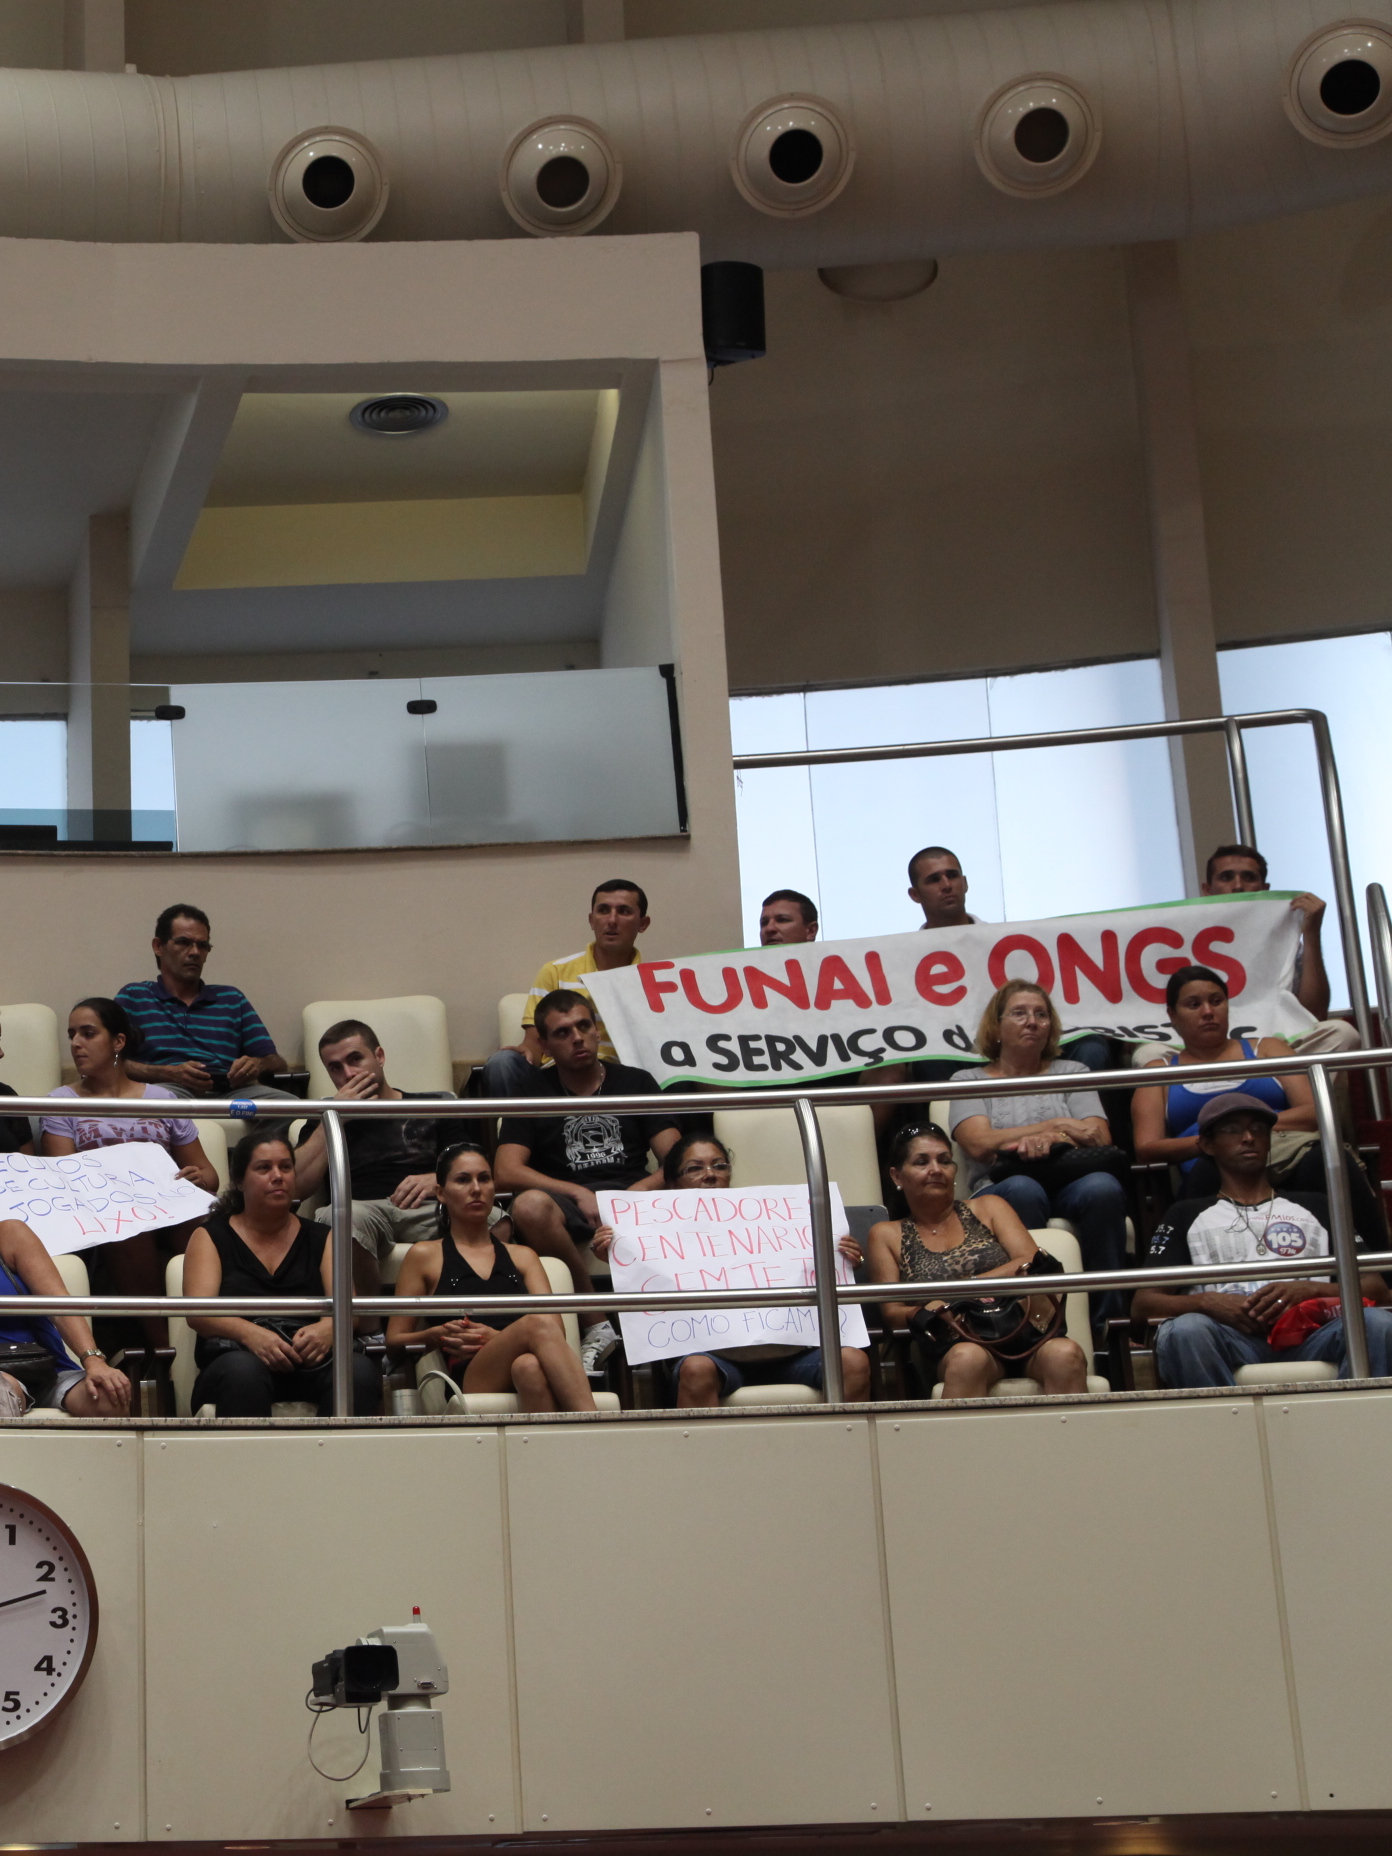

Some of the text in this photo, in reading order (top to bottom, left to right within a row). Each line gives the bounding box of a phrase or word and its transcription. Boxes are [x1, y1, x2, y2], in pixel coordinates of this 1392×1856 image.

[636, 925, 1247, 1015] FUNAI e ONGS
[659, 1040, 697, 1068] a
[705, 1025, 927, 1072] SERVIÇO
[28, 1170, 155, 1194] CULTURA
[9, 1190, 158, 1224] JOGADOS
[610, 1196, 812, 1227] PESCADORE
[73, 1204, 176, 1236] LIXO!
[1267, 1231, 1304, 1249] 105
[647, 1314, 731, 1348] COMO
[4, 1524, 17, 1546] 1
[35, 1560, 56, 1583] 2
[48, 1606, 70, 1629] 3
[33, 1655, 56, 1677] 4
[1, 1690, 22, 1713] 5
